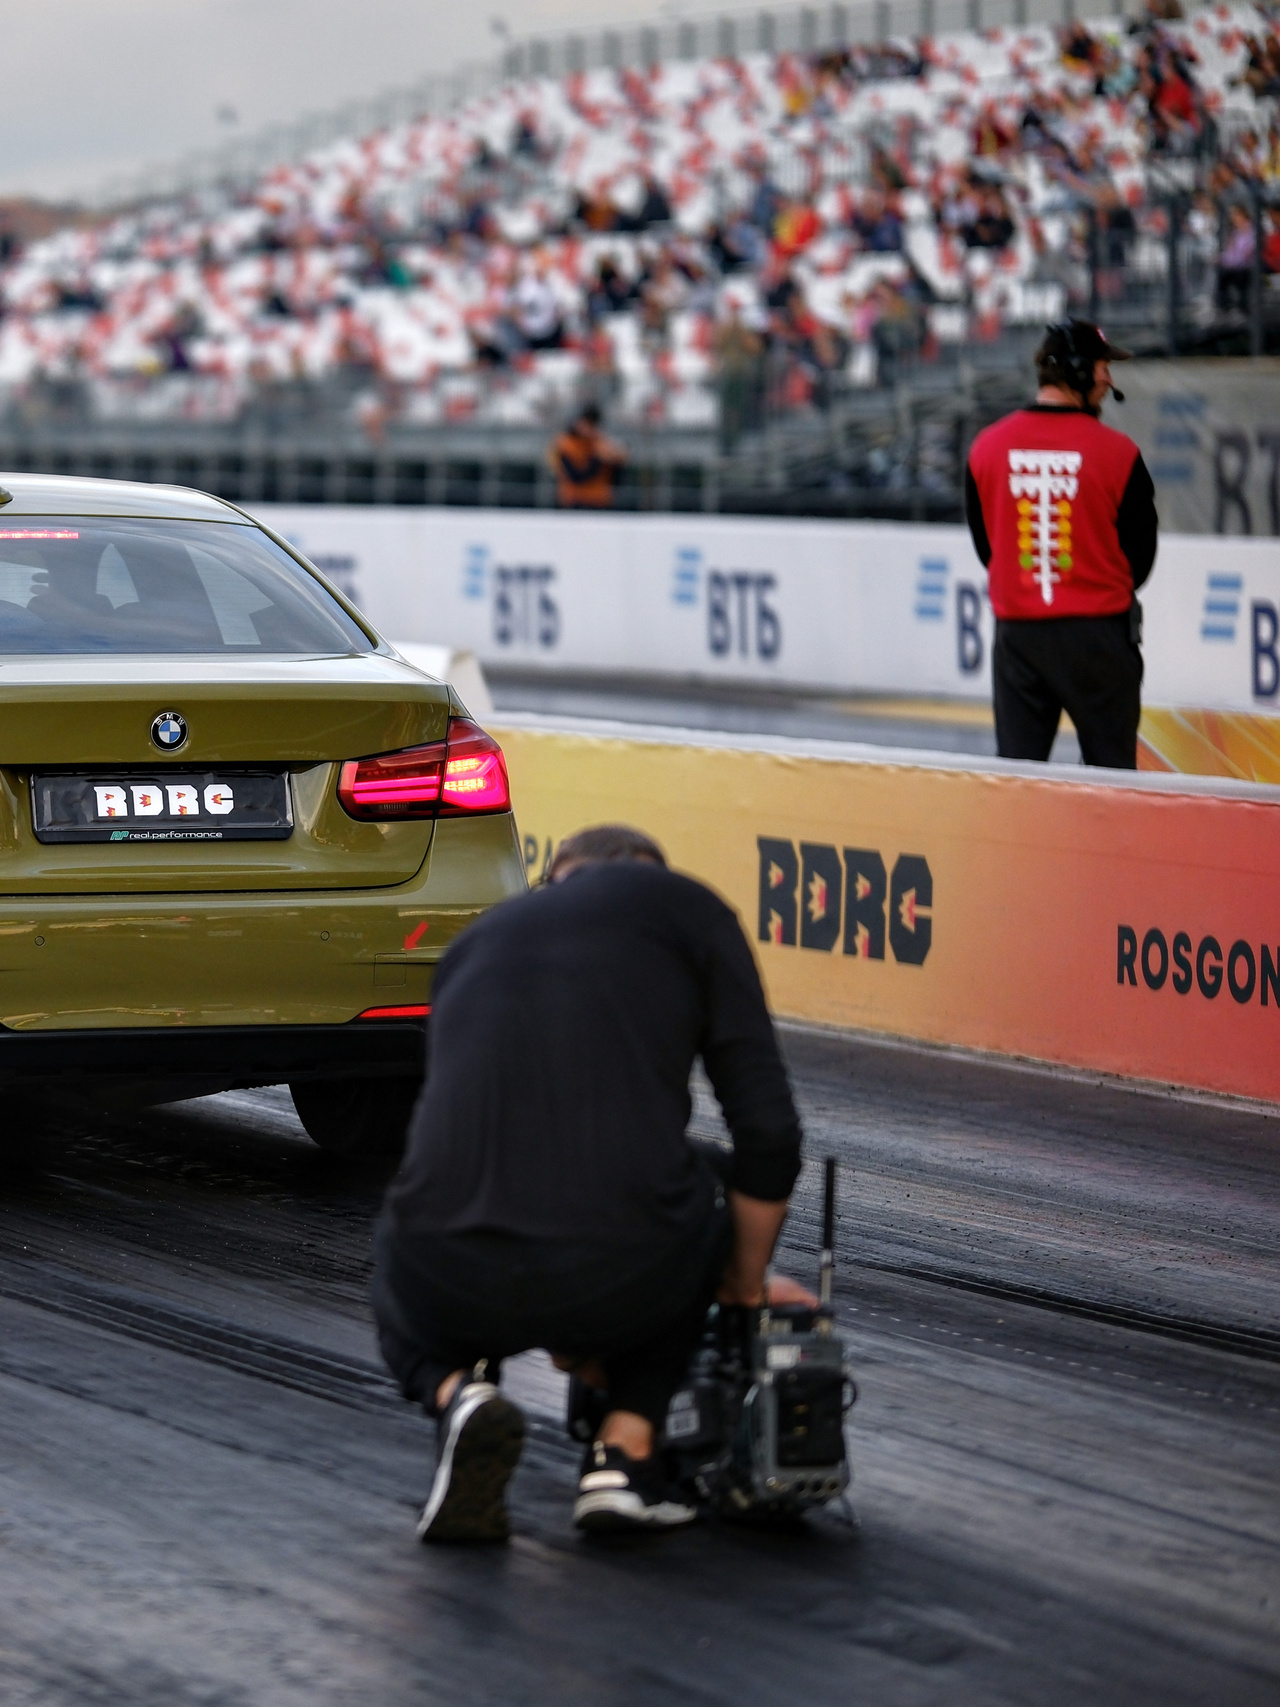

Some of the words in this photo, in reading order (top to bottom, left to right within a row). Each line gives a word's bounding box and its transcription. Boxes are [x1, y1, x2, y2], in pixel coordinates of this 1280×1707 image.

[706, 569, 783, 660] ВТБ
[155, 713, 186, 726] BMW
[94, 784, 235, 817] RDRC
[756, 834, 933, 968] RDRC
